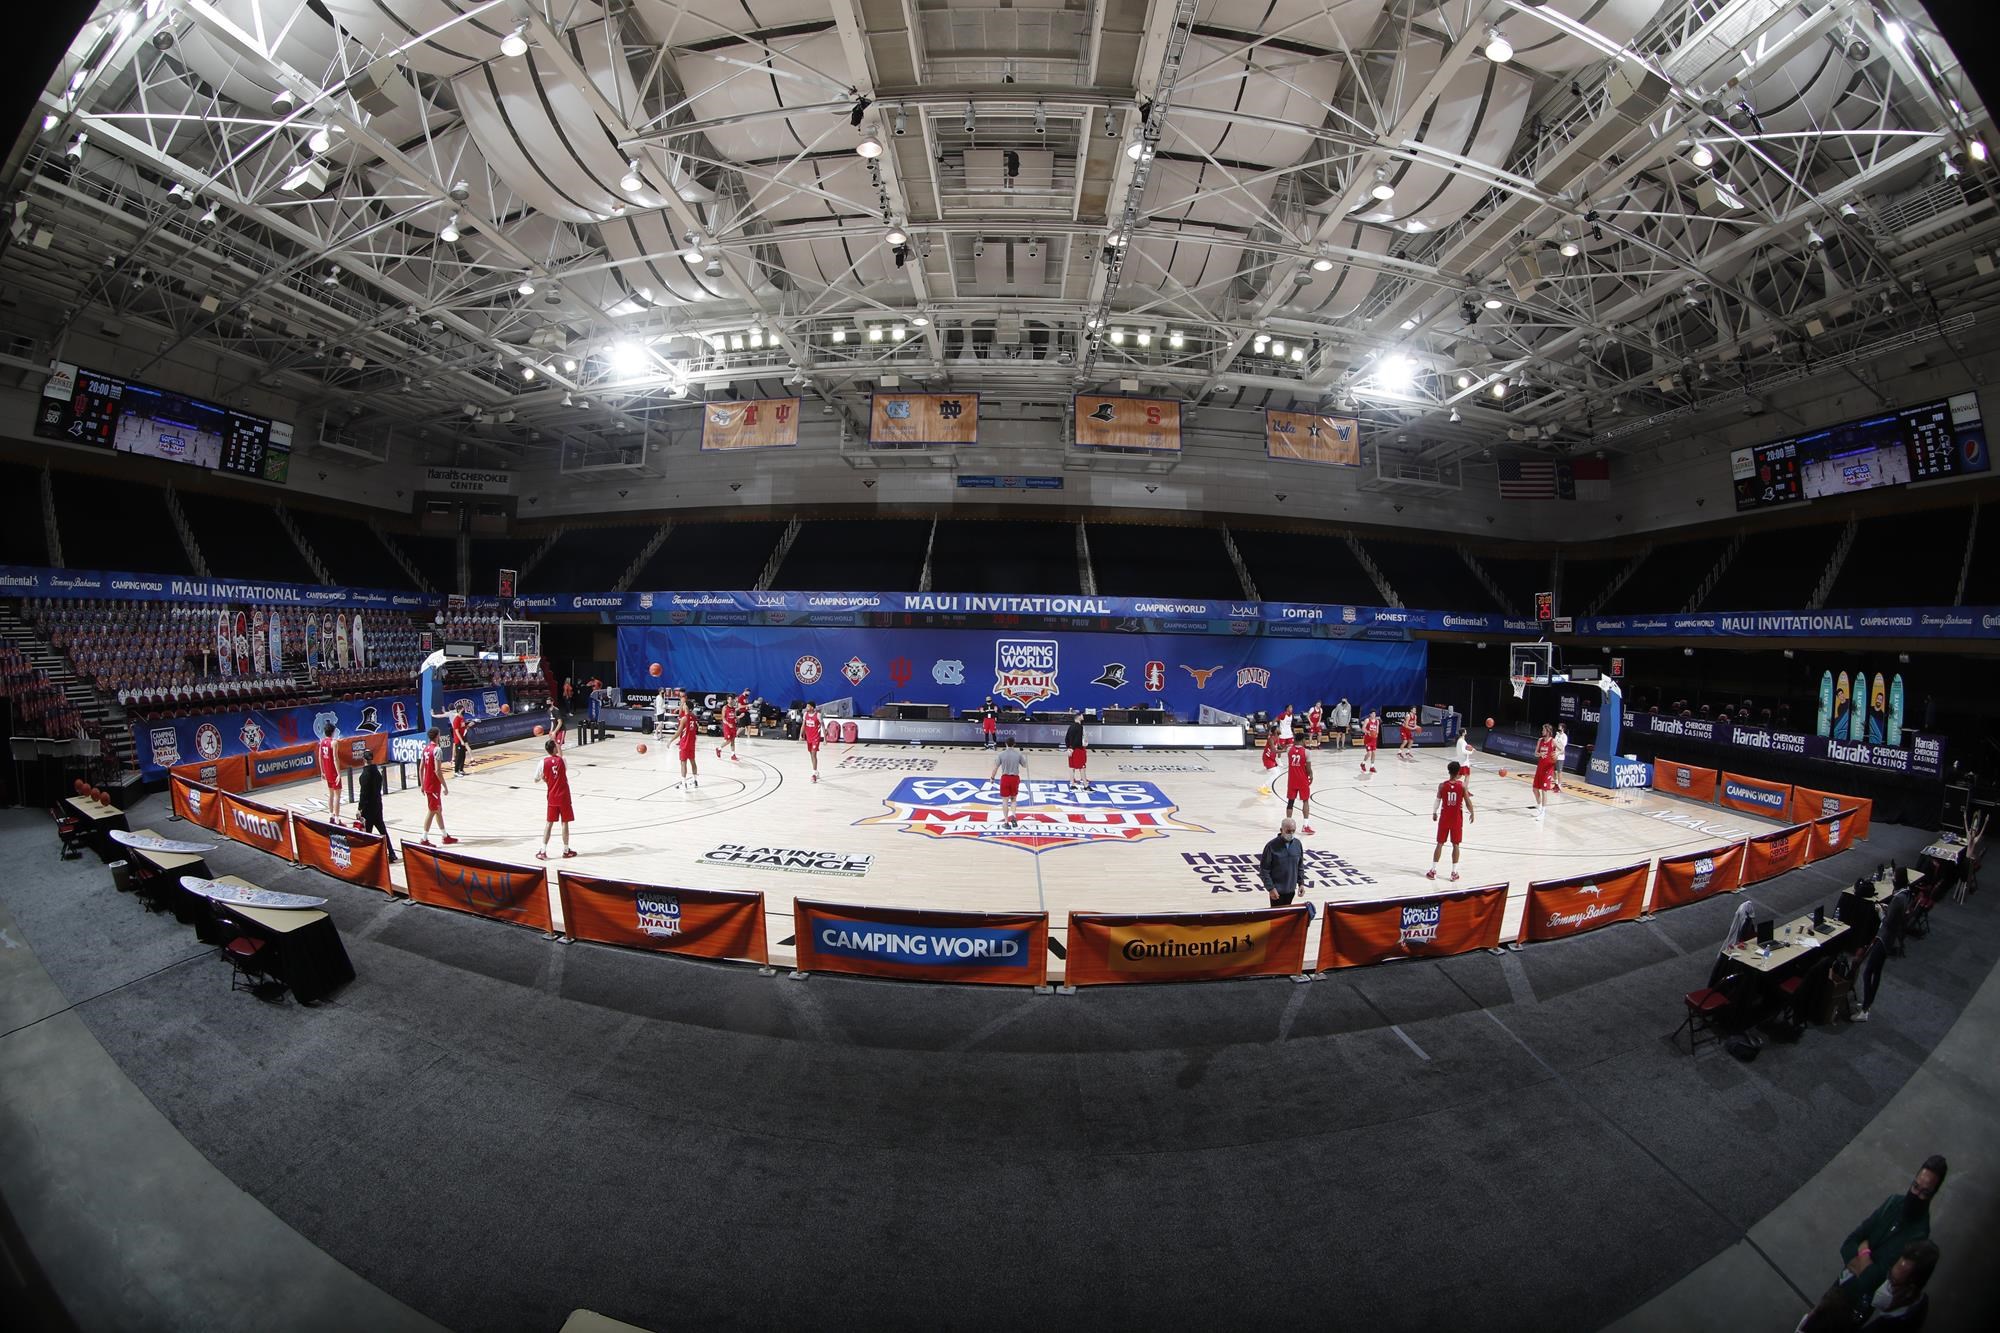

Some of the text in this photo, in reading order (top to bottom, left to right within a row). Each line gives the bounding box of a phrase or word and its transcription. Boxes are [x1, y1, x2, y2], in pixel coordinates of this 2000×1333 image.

[461, 472, 508, 483] CHEROKEE
[451, 481, 484, 490] CENTER
[0, 576, 33, 587] ntinental
[112, 580, 163, 592] CAMPING WORLD
[172, 582, 300, 601] MAUI INVITATIONAL
[306, 591, 346, 601] CAMPING WORLD
[582, 598, 622, 607] GATORADE
[672, 595, 734, 608] Tommy Bahama
[810, 598, 880, 607] CAMPING WORLD
[905, 596, 1110, 614] MAUI INVITATIONAL
[1135, 604, 1206, 614] CAMPING WORLD
[1283, 607, 1322, 619] roman
[1164, 622, 1207, 630] CAMPING WORLD
[1444, 616, 1484, 627] Continental
[1674, 620, 1714, 629] CAMPING WORLD
[1722, 616, 1853, 631] MAUI INVITATIONAL
[1860, 617, 1912, 627] CAMPING WORLD
[1921, 615, 1972, 628] Tommy Bahama
[1270, 626, 1289, 634] CAMPING
[1001, 645, 1053, 657] CAMPING
[1001, 656, 1054, 669] WORLD
[1003, 676, 1050, 687] MAUI
[1236, 667, 1270, 689] UNLV
[1582, 708, 1600, 724] Harra
[898, 725, 942, 735] Theraworx
[1650, 716, 1683, 734] Harrah's
[1684, 721, 1713, 732] CHEROKEE
[152, 731, 174, 740] CAMPING
[1684, 729, 1712, 740] CASINOS
[1732, 728, 1770, 748] Harrah's
[1772, 732, 1805, 745] CHEROKEE
[154, 738, 174, 747] WORLD
[392, 738, 426, 750] CAMPING
[1772, 743, 1804, 754] CASINOS
[1914, 737, 1940, 751] Harrah's
[393, 748, 422, 762] WORL
[1827, 740, 1870, 764] Harrah's
[1872, 747, 1908, 760] CHEROKEE
[1914, 749, 1939, 758] CHEROKEE
[258, 756, 313, 776] CAMPING WORLD
[1591, 758, 1610, 768] CAMPING
[1872, 758, 1907, 770] CASINOS
[1914, 755, 1938, 765] CASINOS
[552, 766, 558, 776] 5
[1591, 765, 1609, 774] WORLD
[1615, 763, 1646, 778] CAMPING
[1615, 774, 1646, 788] WORLD
[912, 788, 1157, 805] WORLD
[1726, 785, 1782, 806] CAMPING WORLD
[912, 808, 1157, 826] MAUI
[232, 810, 283, 843] roman
[1641, 809, 1754, 840] MAUI
[332, 851, 351, 860] MAUI
[716, 844, 837, 860] PLATING
[704, 851, 870, 872] CHANGE
[1695, 864, 1714, 874] WORLD
[432, 857, 515, 906] MAUI
[636, 892, 678, 905] CAMPING
[638, 901, 679, 915] WORLD
[1403, 911, 1439, 925] WORLD
[1546, 902, 1622, 933] Tommy Bahama
[642, 918, 678, 931] MAUI
[1402, 928, 1434, 938] MAUI
[822, 928, 1019, 959] CAMPING WORLD
[1122, 937, 1240, 965] Continental
